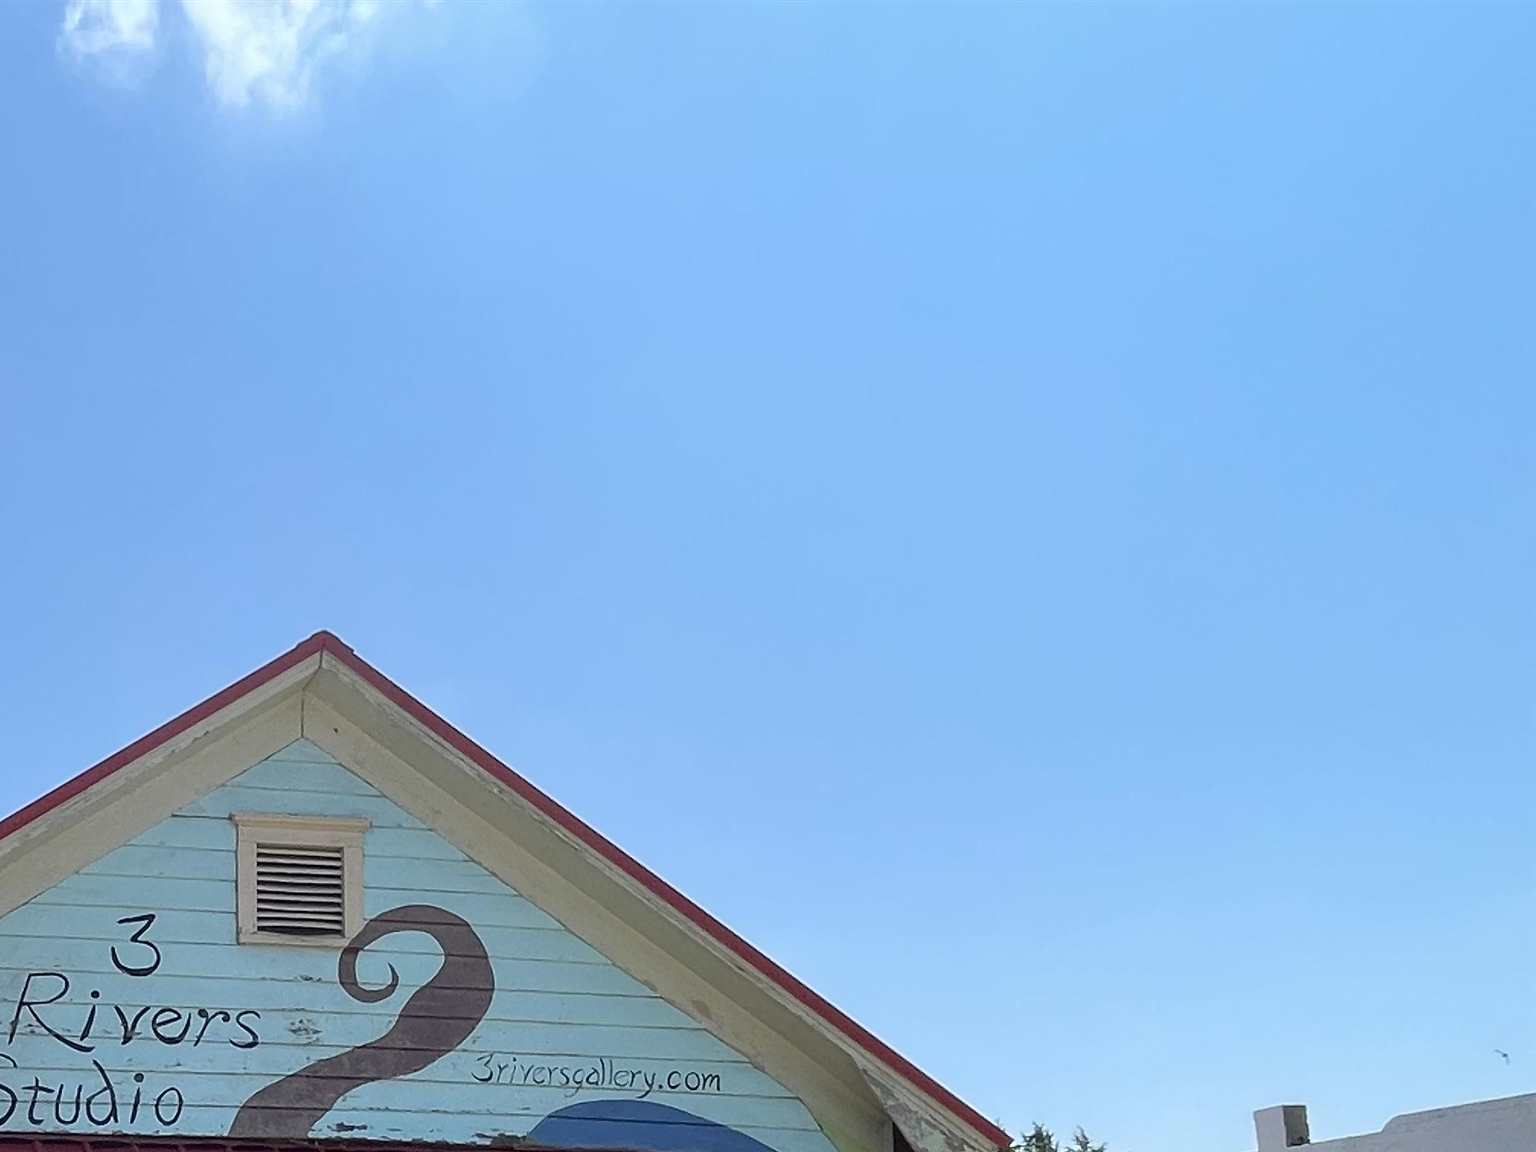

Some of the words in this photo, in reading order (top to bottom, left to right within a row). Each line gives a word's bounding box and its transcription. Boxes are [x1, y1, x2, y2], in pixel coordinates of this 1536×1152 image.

[110, 913, 162, 977] 3
[7, 972, 263, 1053] Rivers
[470, 1051, 722, 1099] 3riversgallery.com
